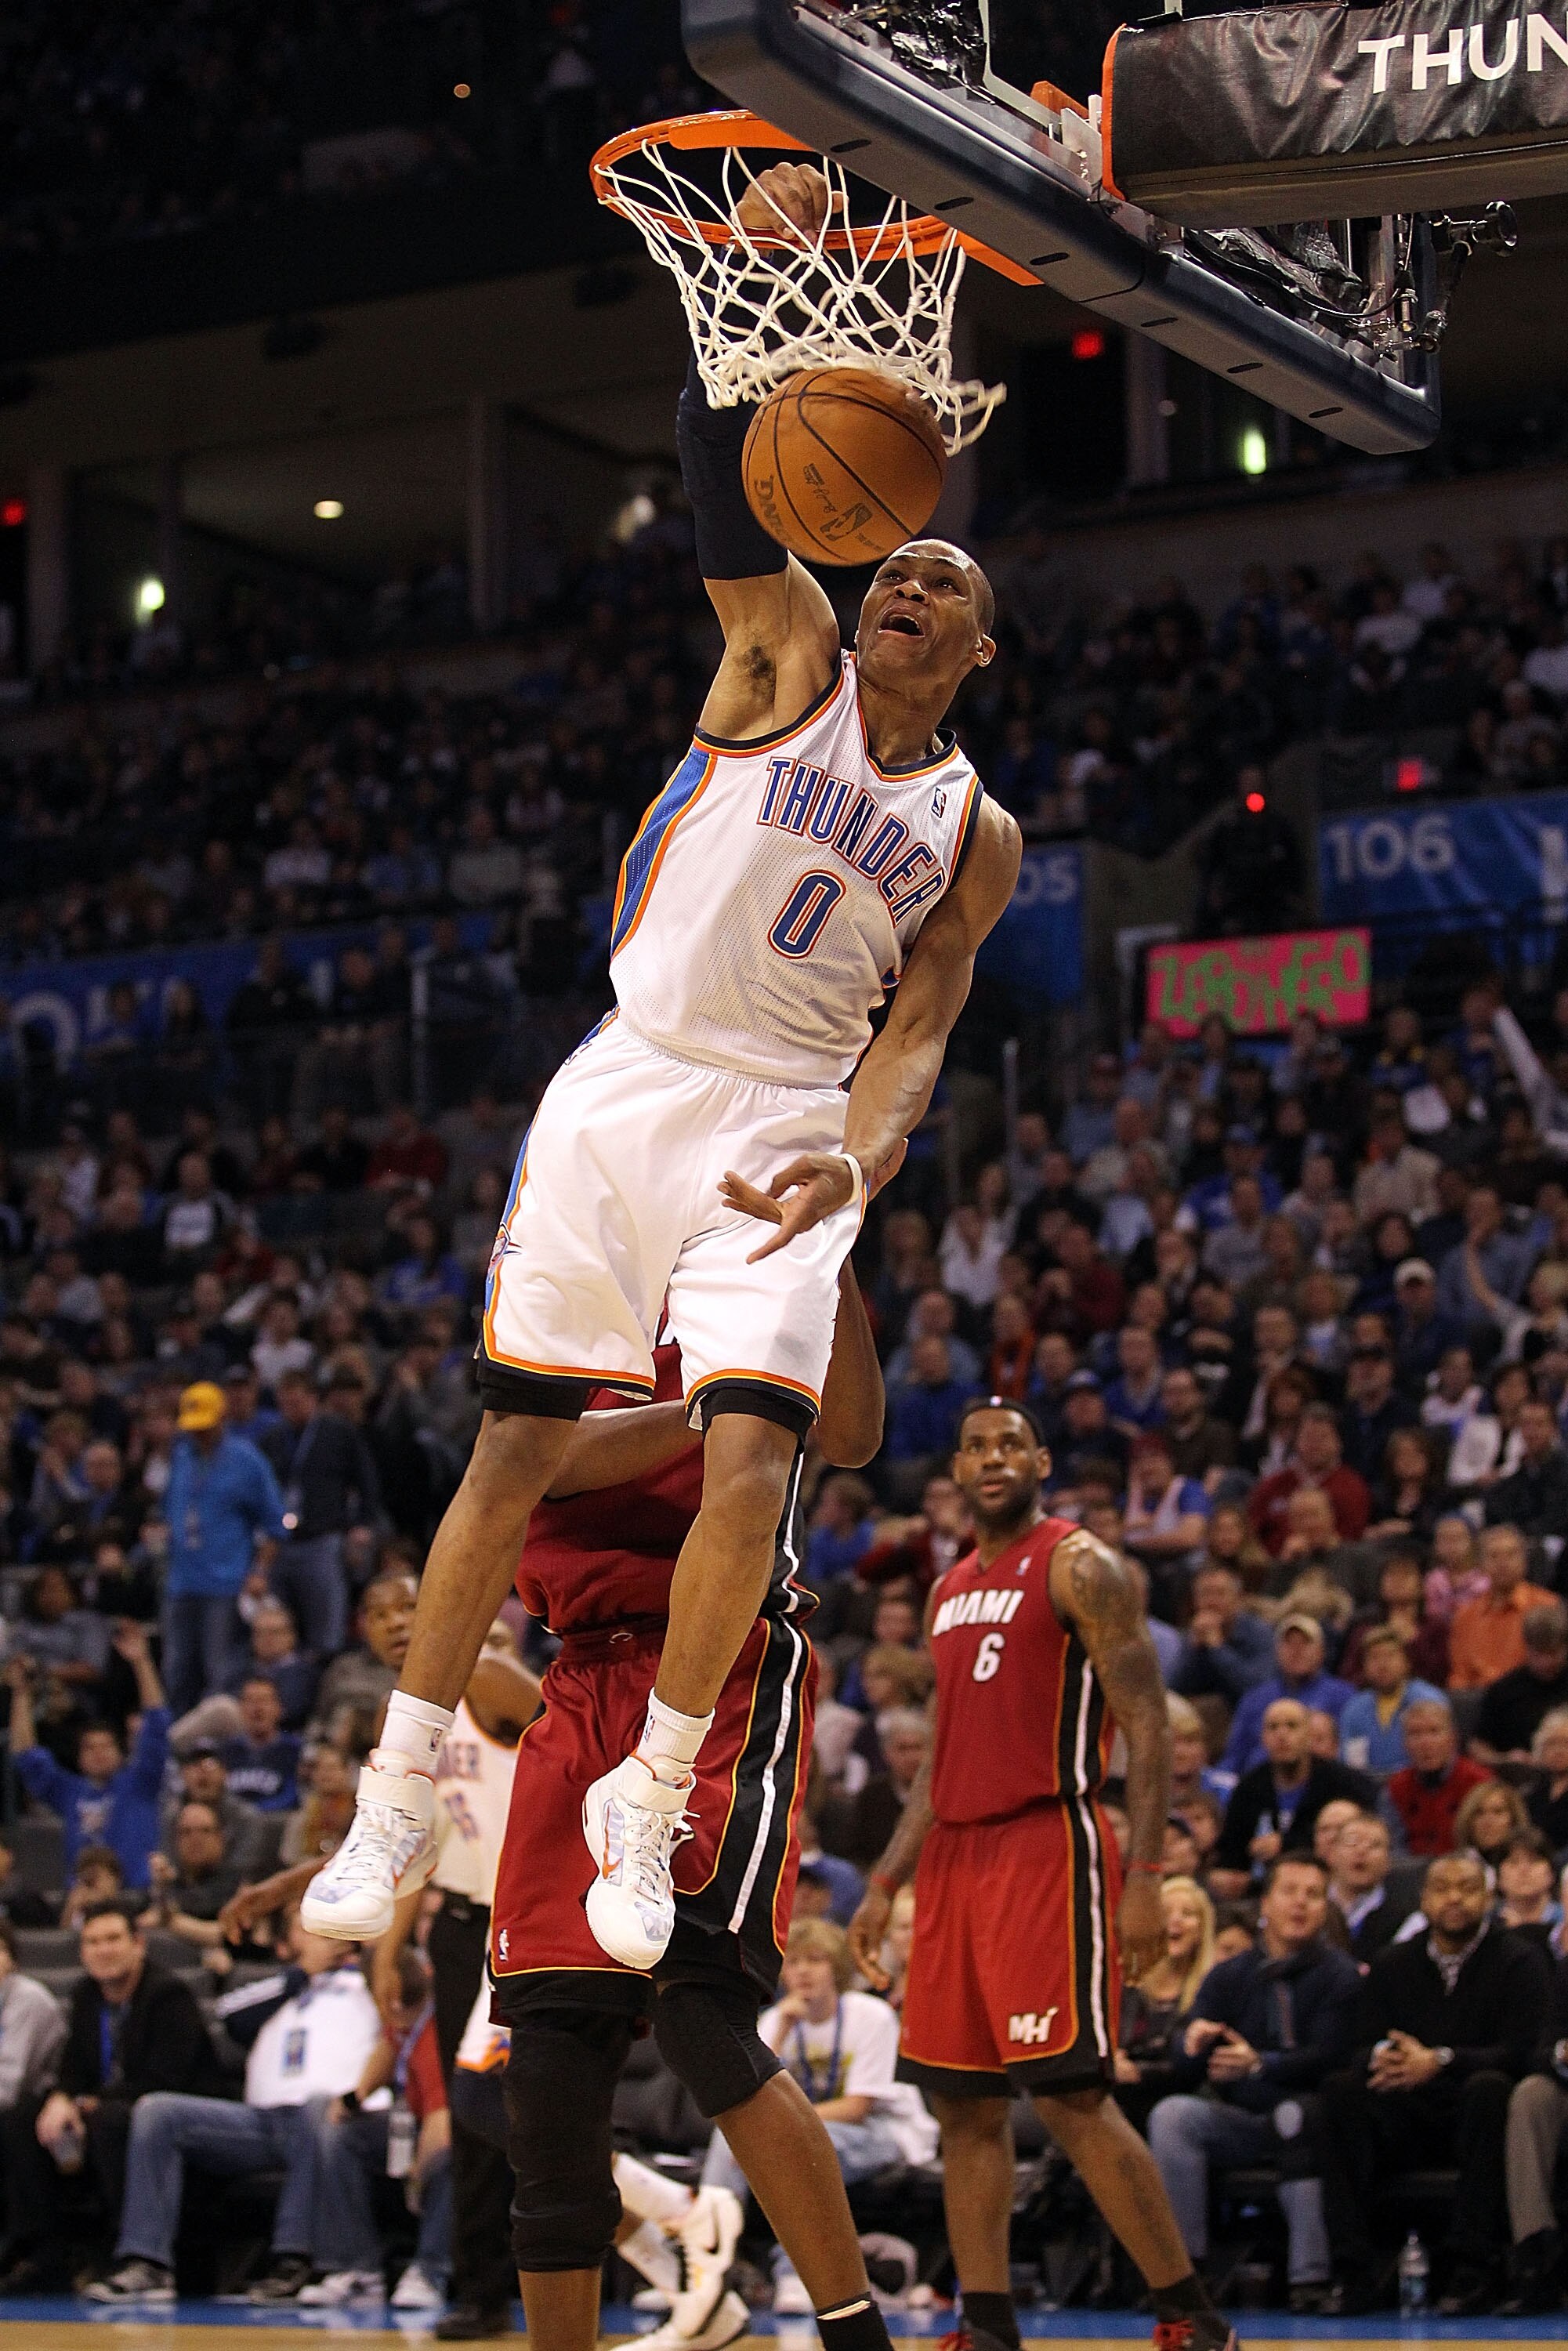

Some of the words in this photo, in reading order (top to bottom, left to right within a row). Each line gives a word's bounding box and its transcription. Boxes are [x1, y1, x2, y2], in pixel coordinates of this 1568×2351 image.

[1358, 13, 1568, 94] THUN
[756, 756, 947, 929] THUNDER
[1327, 813, 1455, 884] 106
[767, 868, 846, 960] 0
[1013, 855, 1077, 905] 05
[932, 1589, 1025, 1636] MIAMI
[972, 1632, 1005, 1683] 6
